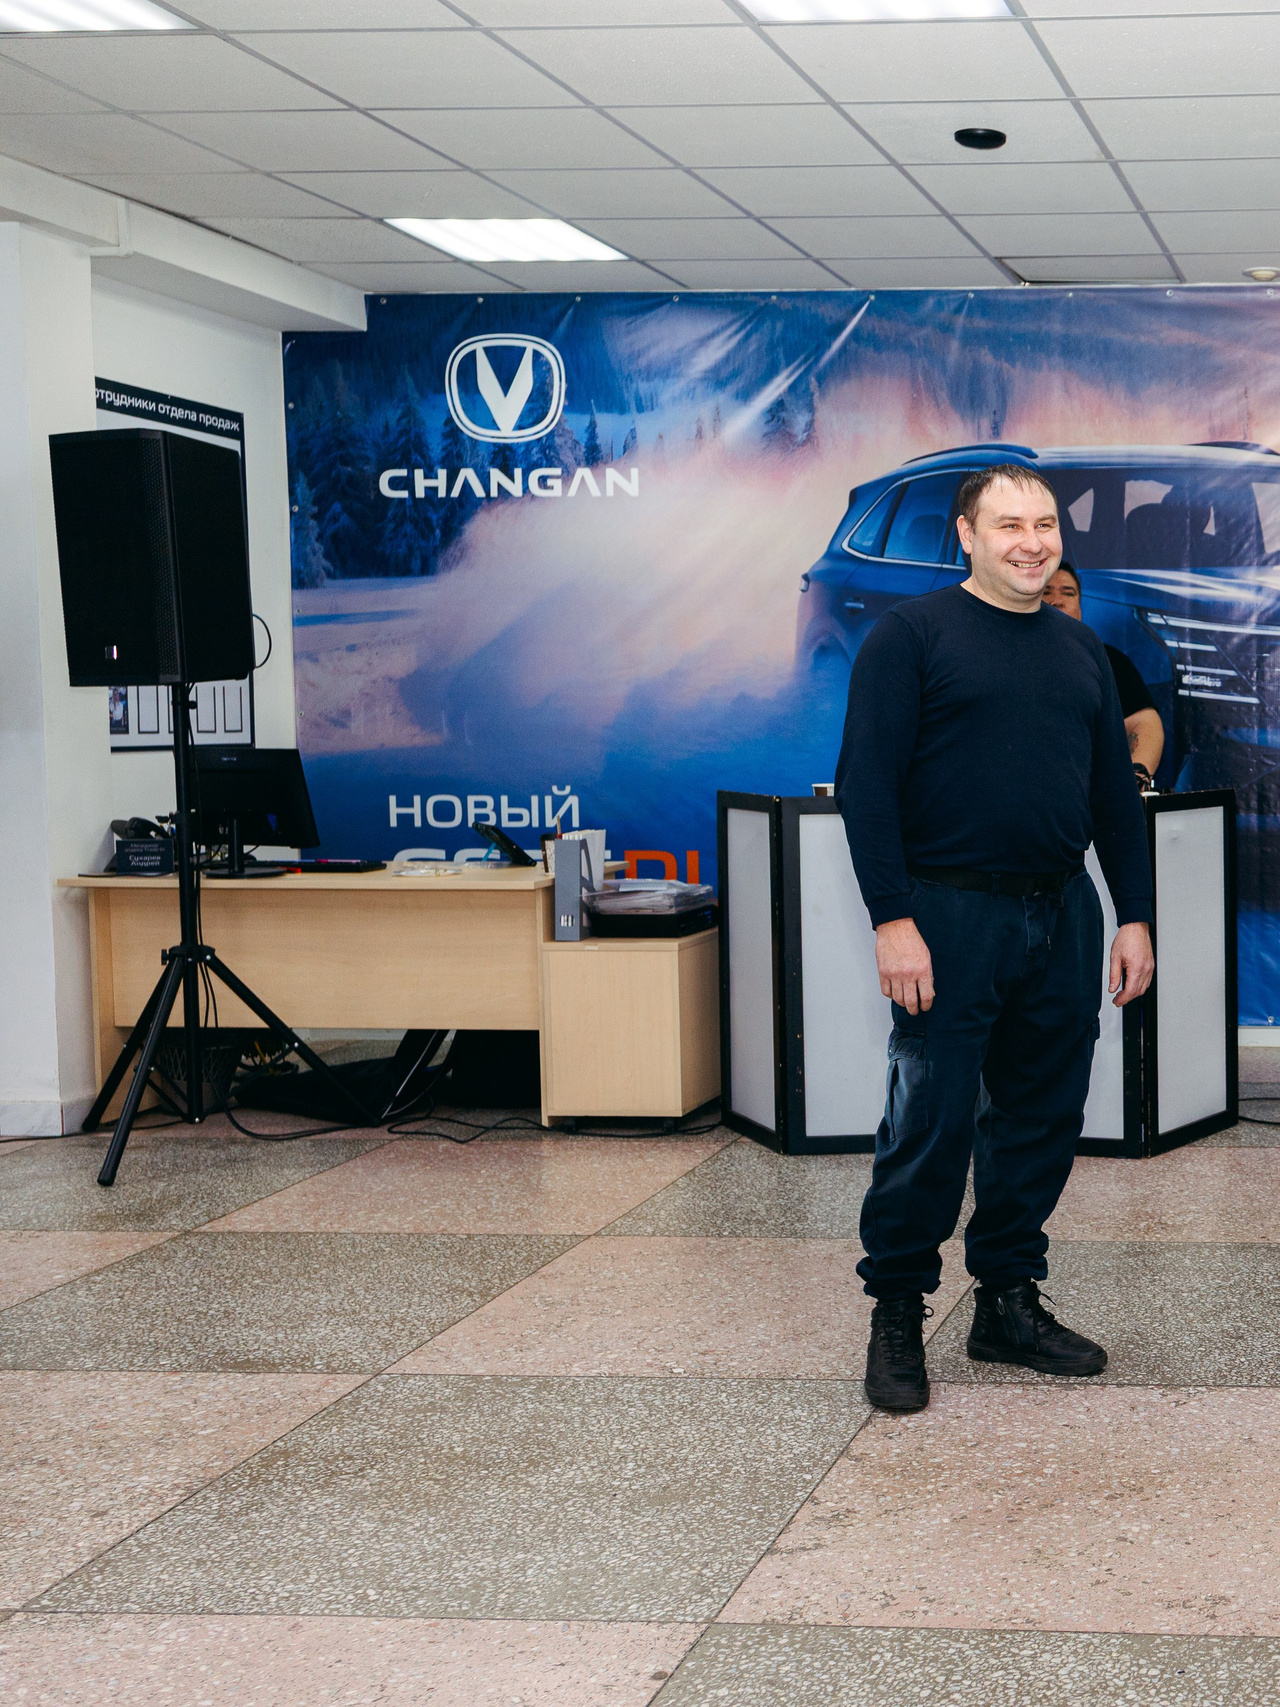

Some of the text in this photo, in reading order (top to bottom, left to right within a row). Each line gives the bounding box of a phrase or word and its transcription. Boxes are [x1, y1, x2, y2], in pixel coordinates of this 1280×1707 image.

[158, 404, 197, 421] отдела
[199, 413, 240, 432] продаж
[379, 467, 640, 499] CHANGAN
[389, 785, 580, 828] НОВЫЙ
